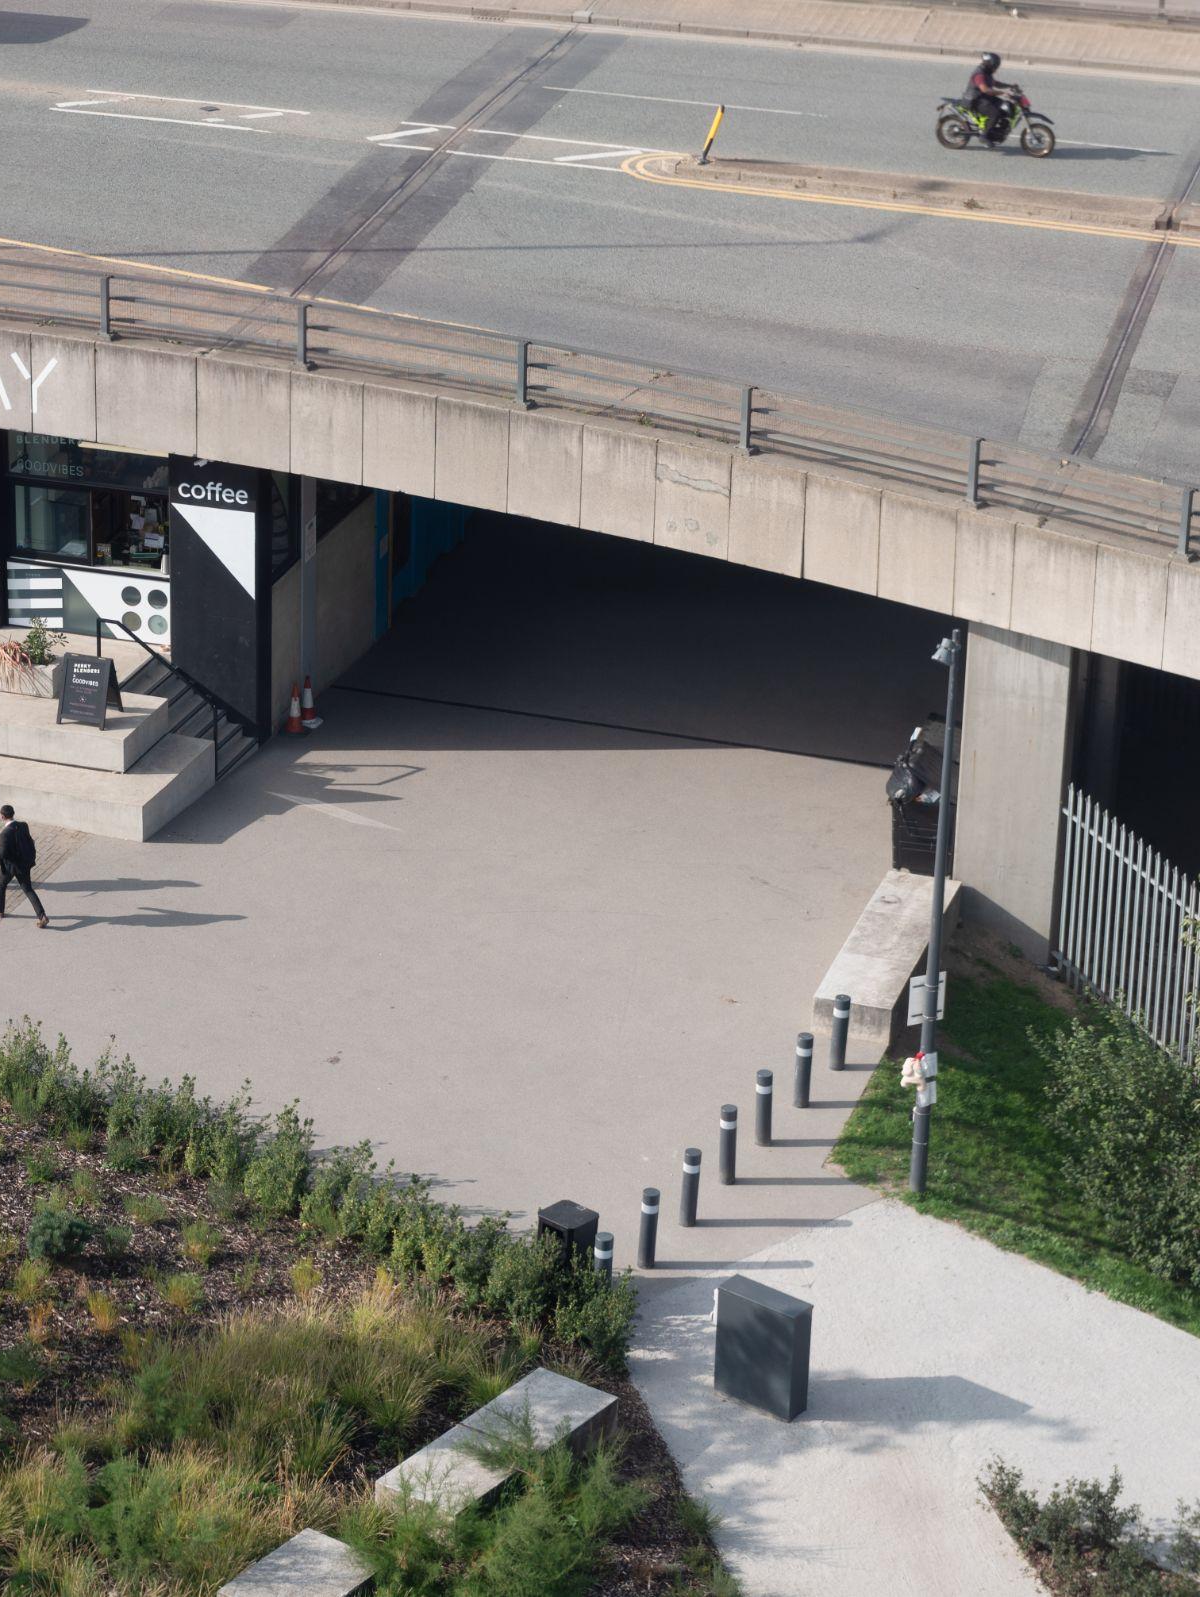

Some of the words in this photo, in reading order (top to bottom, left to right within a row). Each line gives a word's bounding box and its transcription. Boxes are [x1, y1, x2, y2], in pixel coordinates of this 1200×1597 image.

[16, 434, 81, 446] BLENDER
[16, 458, 85, 477] GOODVIBES
[178, 481, 249, 505] coffee
